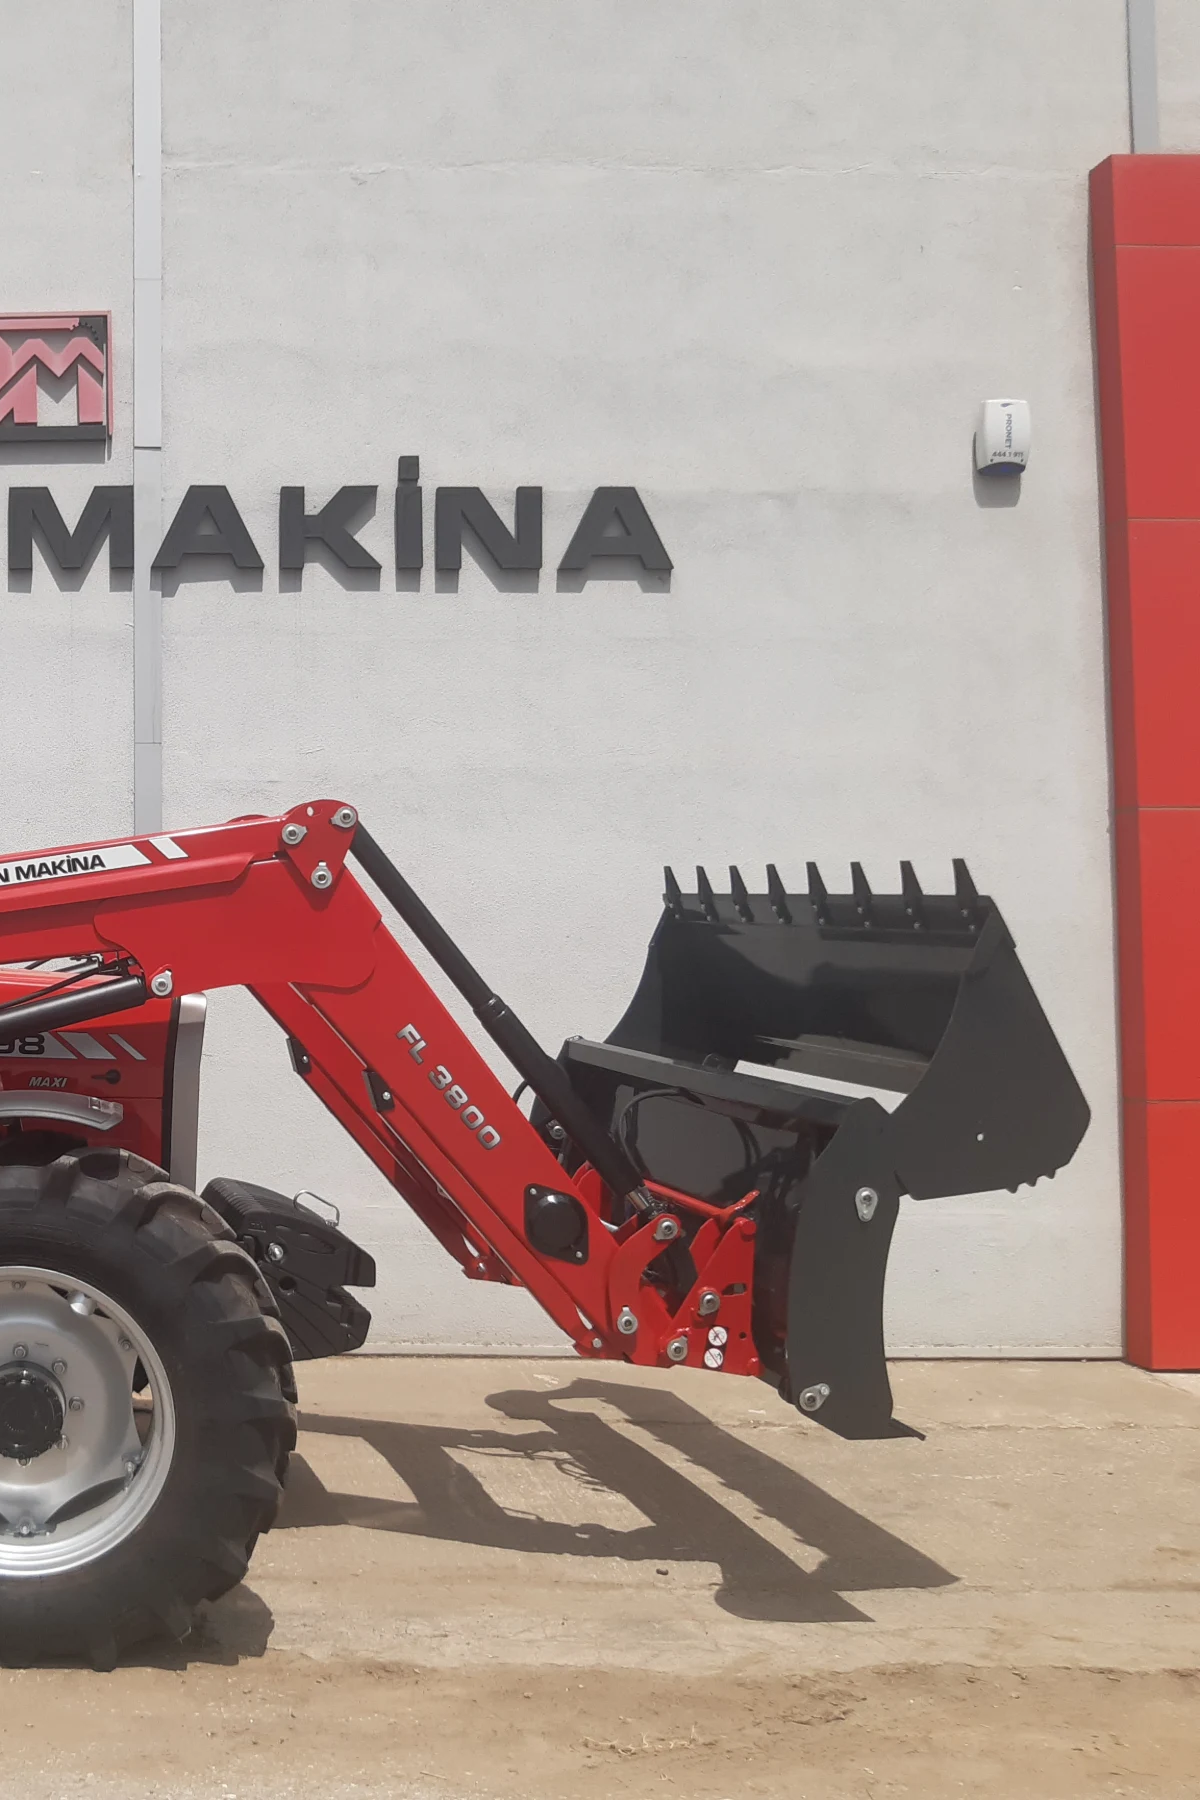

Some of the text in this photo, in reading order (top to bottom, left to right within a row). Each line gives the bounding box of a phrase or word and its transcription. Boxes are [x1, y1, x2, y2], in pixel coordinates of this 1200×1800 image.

[8, 455, 674, 570] MAKİNA
[14, 855, 106, 881] MAKİNA
[28, 1076, 68, 1088] MAXI
[396, 1023, 501, 1150] FL 3800
